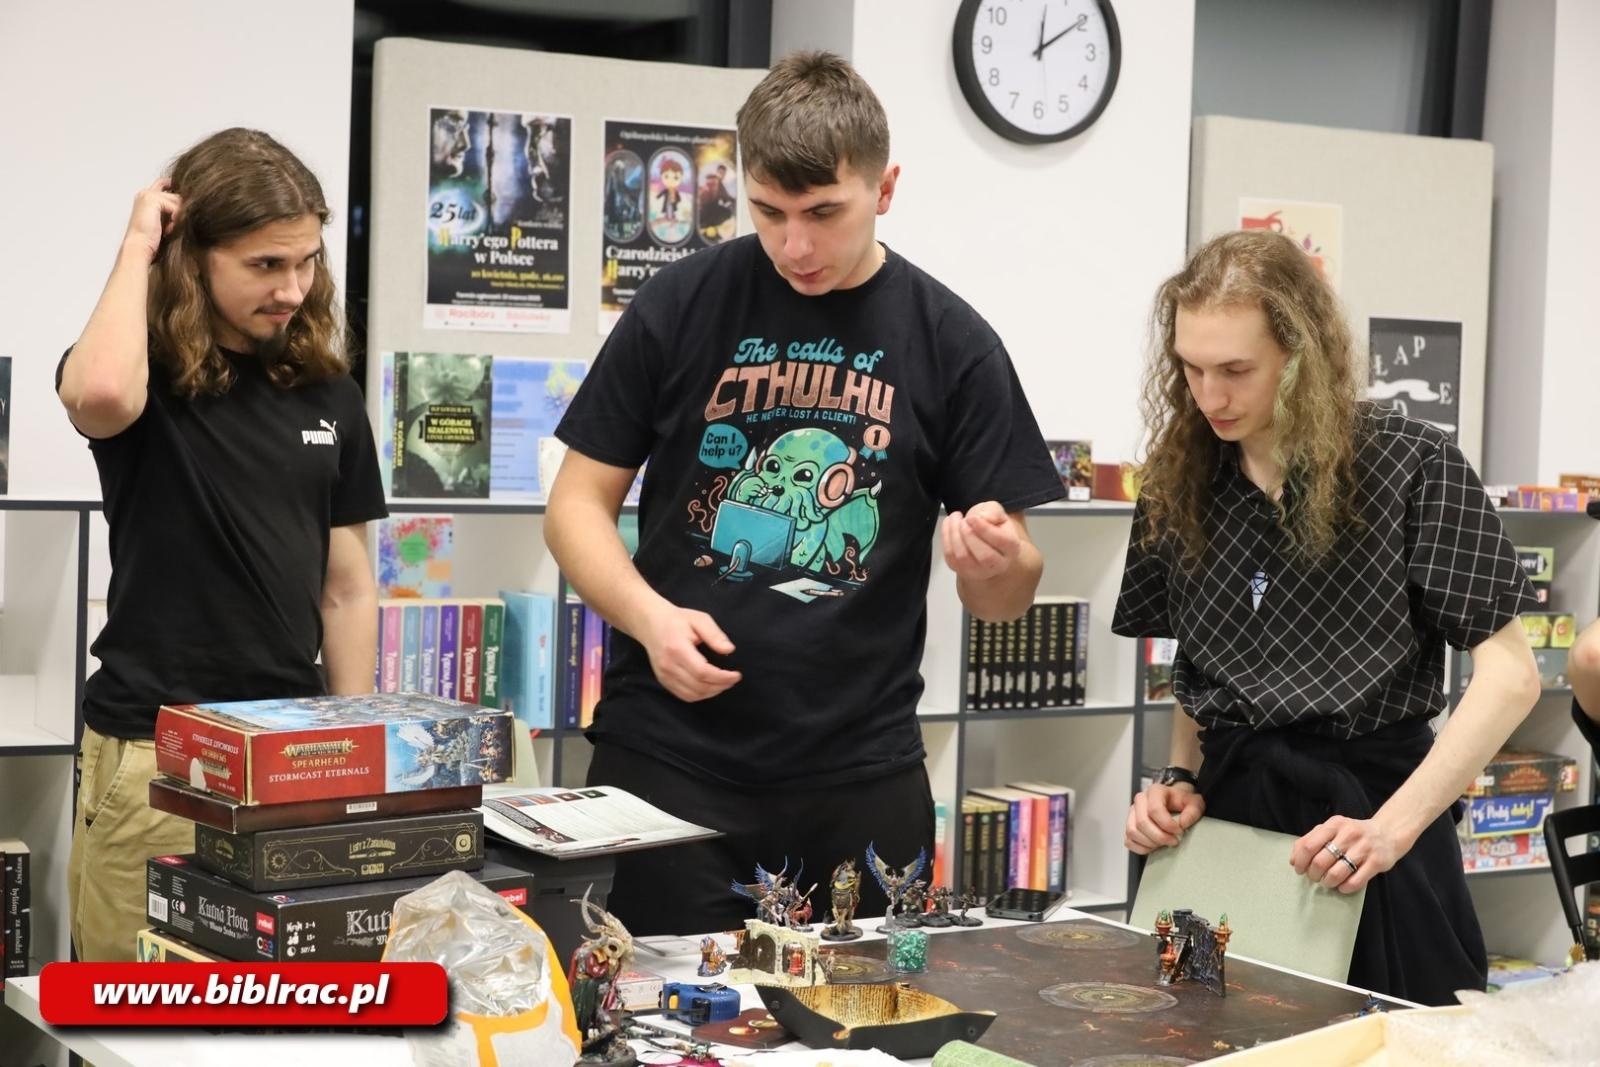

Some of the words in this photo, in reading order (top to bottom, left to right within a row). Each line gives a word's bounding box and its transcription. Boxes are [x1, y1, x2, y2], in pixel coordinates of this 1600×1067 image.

[988, 7, 1007, 26] 10
[1076, 13, 1088, 32] 2
[981, 36, 993, 54] 9
[1085, 43, 1096, 62] 3
[988, 68, 1000, 86] 8
[1078, 75, 1088, 91] 4
[1009, 92, 1020, 109] 7
[1058, 95, 1070, 113] 5
[1033, 101, 1044, 120] 6
[430, 202, 457, 223] 25
[511, 225, 560, 250] Pottera
[474, 252, 487, 264] w
[489, 250, 535, 267] Polsce
[733, 337, 778, 364] The
[787, 337, 846, 363] calls
[853, 350, 884, 373] of
[1413, 335, 1426, 358] P
[704, 361, 895, 424] CTHULHU
[746, 413, 758, 424] HE
[760, 408, 787, 421] NEVER
[789, 409, 812, 420] LOST
[813, 410, 820, 420] A
[822, 412, 857, 425] CLIENT!
[301, 430, 335, 446] PUMA
[706, 432, 727, 444] Can
[731, 432, 736, 444] I
[872, 430, 882, 447] 1
[700, 446, 724, 459] help
[728, 445, 742, 457] u?
[292, 757, 346, 769] SPEARHEAD
[269, 771, 324, 783] STORMCAST
[325, 766, 370, 778] ETERNALS
[502, 892, 524, 902] ebel
[198, 896, 225, 923] Kutná
[226, 905, 249, 932] Hora
[346, 909, 392, 936] Kut
